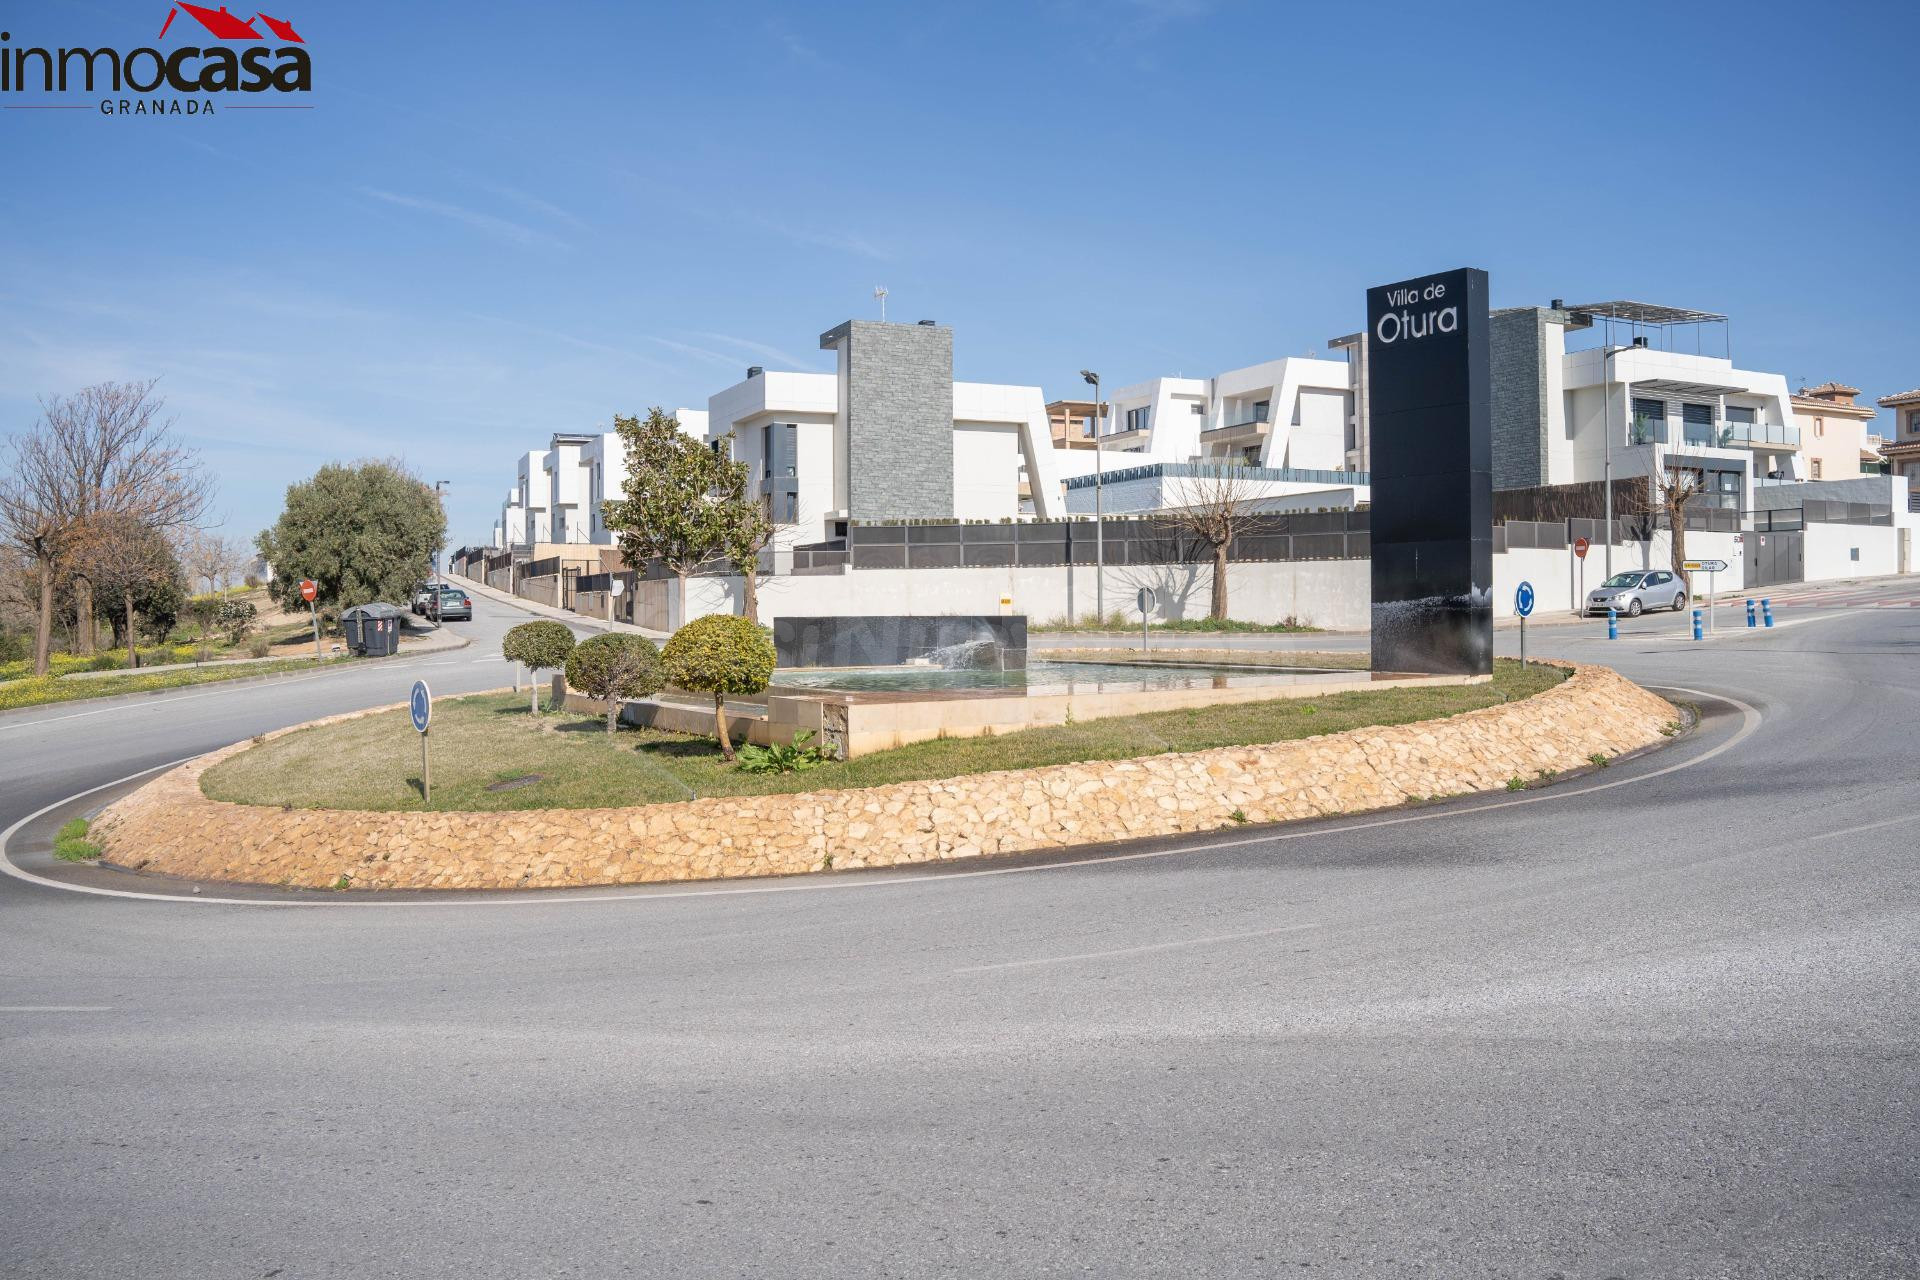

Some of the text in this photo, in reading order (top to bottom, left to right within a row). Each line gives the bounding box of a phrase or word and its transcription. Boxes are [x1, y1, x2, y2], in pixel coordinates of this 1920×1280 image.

[1387, 283, 1446, 307] Villa de
[1377, 306, 1458, 343] Otura
